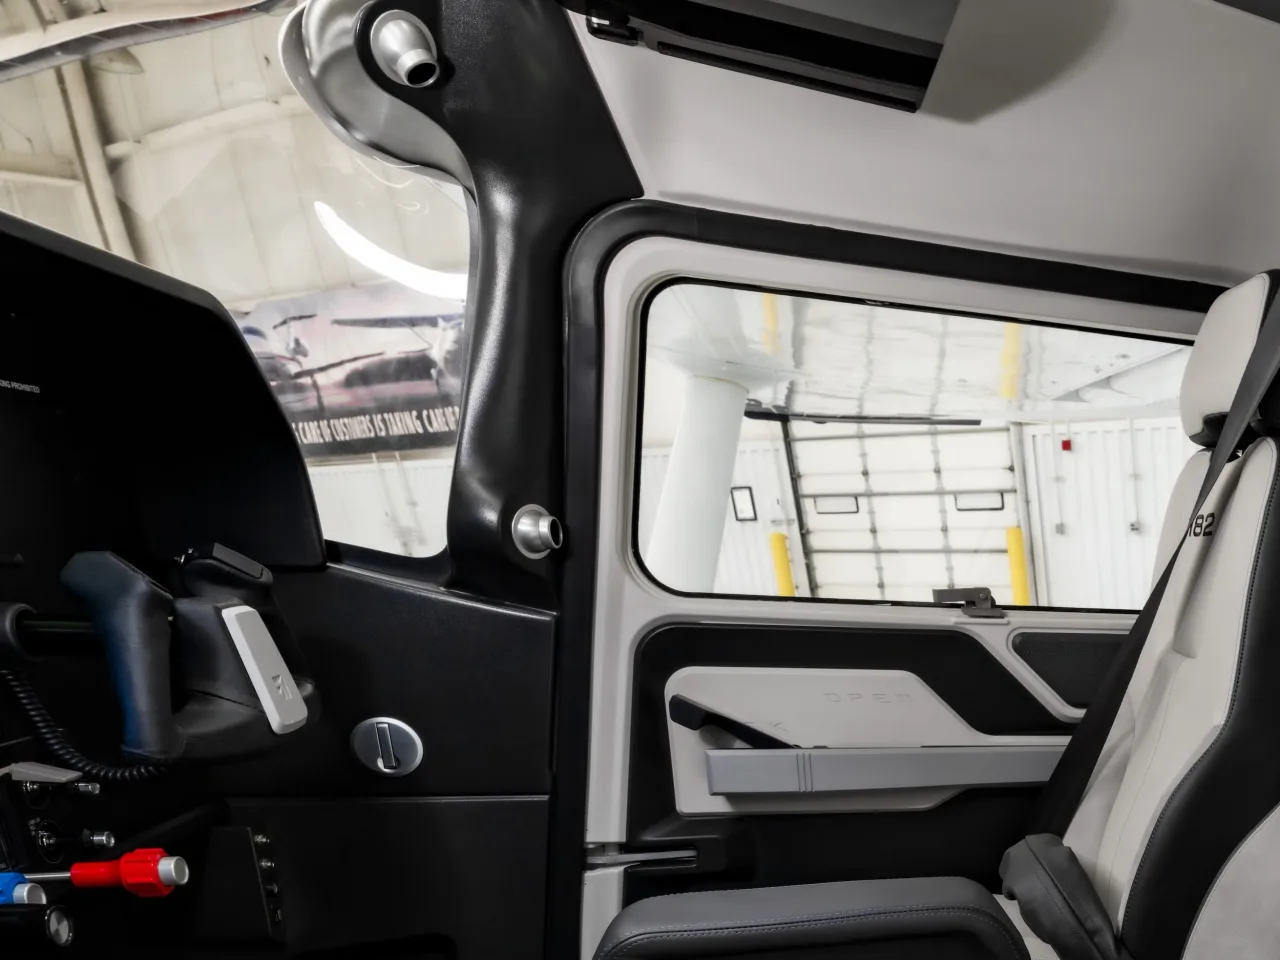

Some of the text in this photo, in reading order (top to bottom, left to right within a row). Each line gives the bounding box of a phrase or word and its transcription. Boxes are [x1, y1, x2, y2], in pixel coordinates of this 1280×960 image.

[298, 421, 324, 444] CARE
[319, 419, 333, 443] OF
[330, 415, 375, 441] CUSTOMERS
[372, 413, 386, 437] IS
[383, 410, 424, 436] TAKING
[422, 407, 449, 433] CARE
